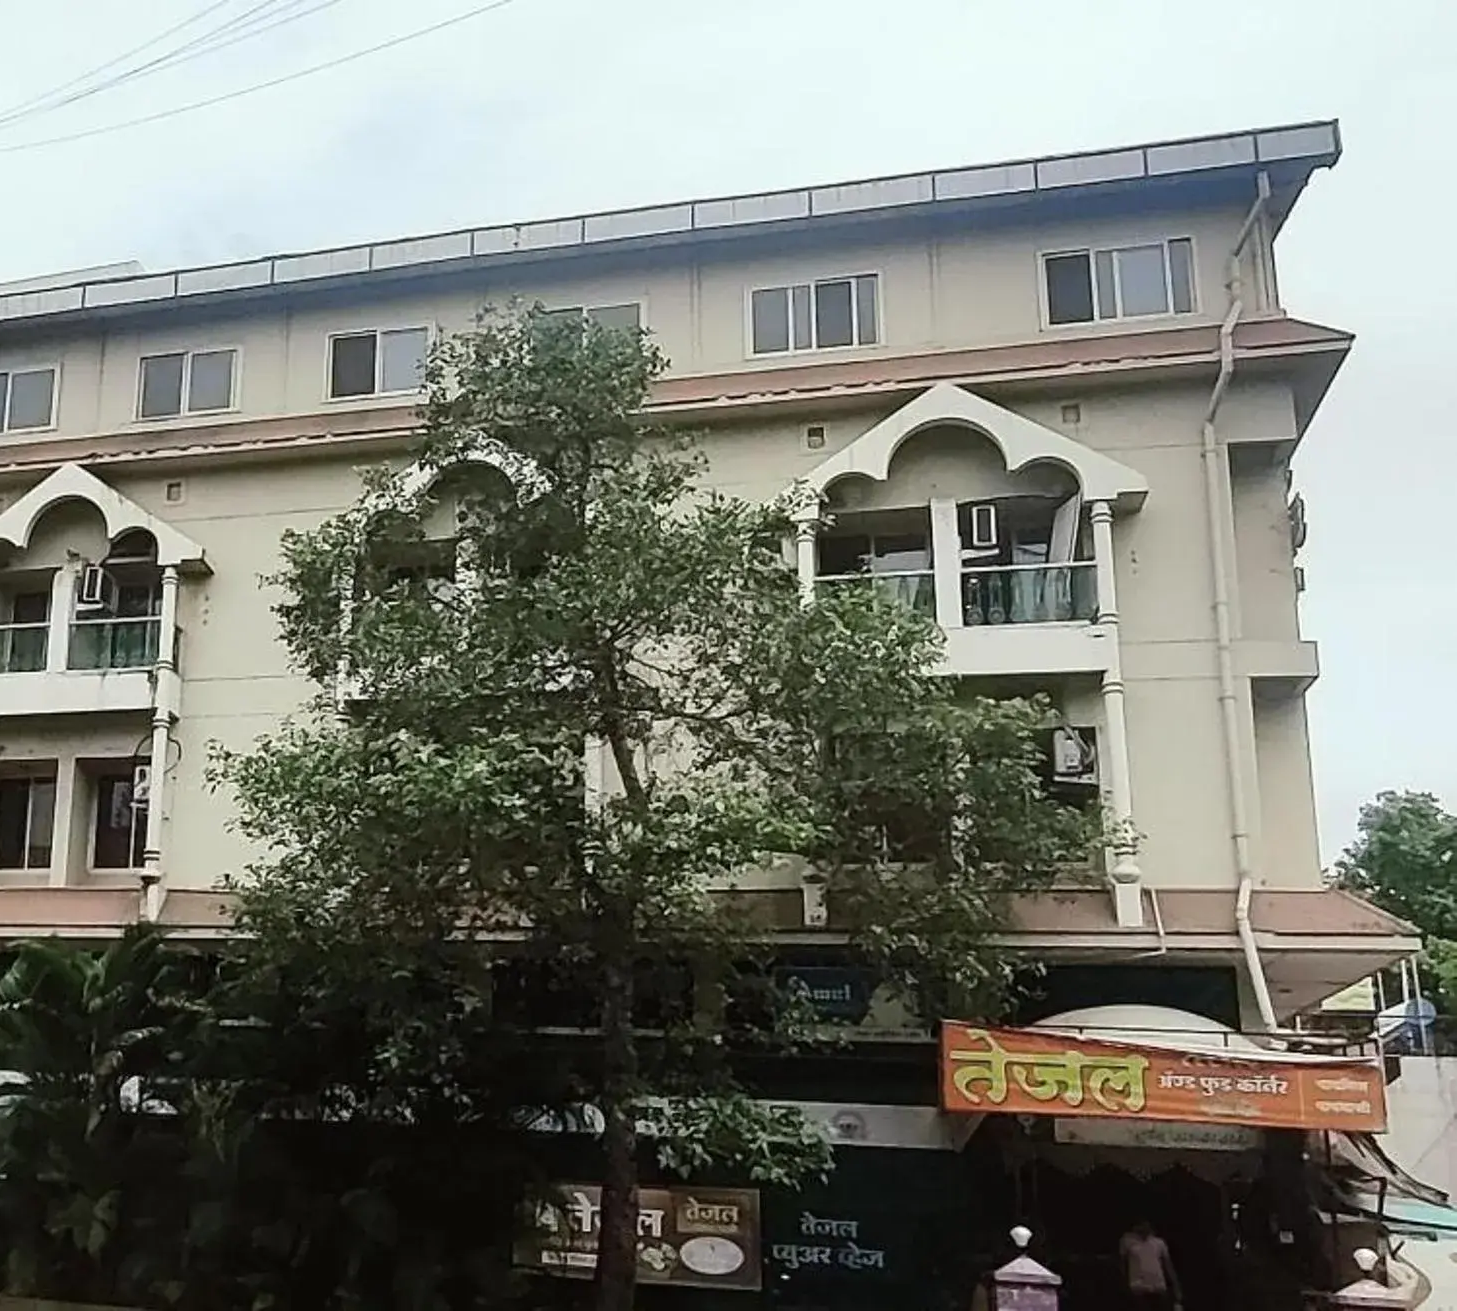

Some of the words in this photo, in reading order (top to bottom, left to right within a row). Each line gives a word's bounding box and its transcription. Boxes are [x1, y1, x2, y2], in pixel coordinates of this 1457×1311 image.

[949, 1028, 1149, 1113] तेजल
[565, 1191, 663, 1238] तेल
[686, 1196, 739, 1223] तेजल
[799, 1211, 859, 1238] तेजल
